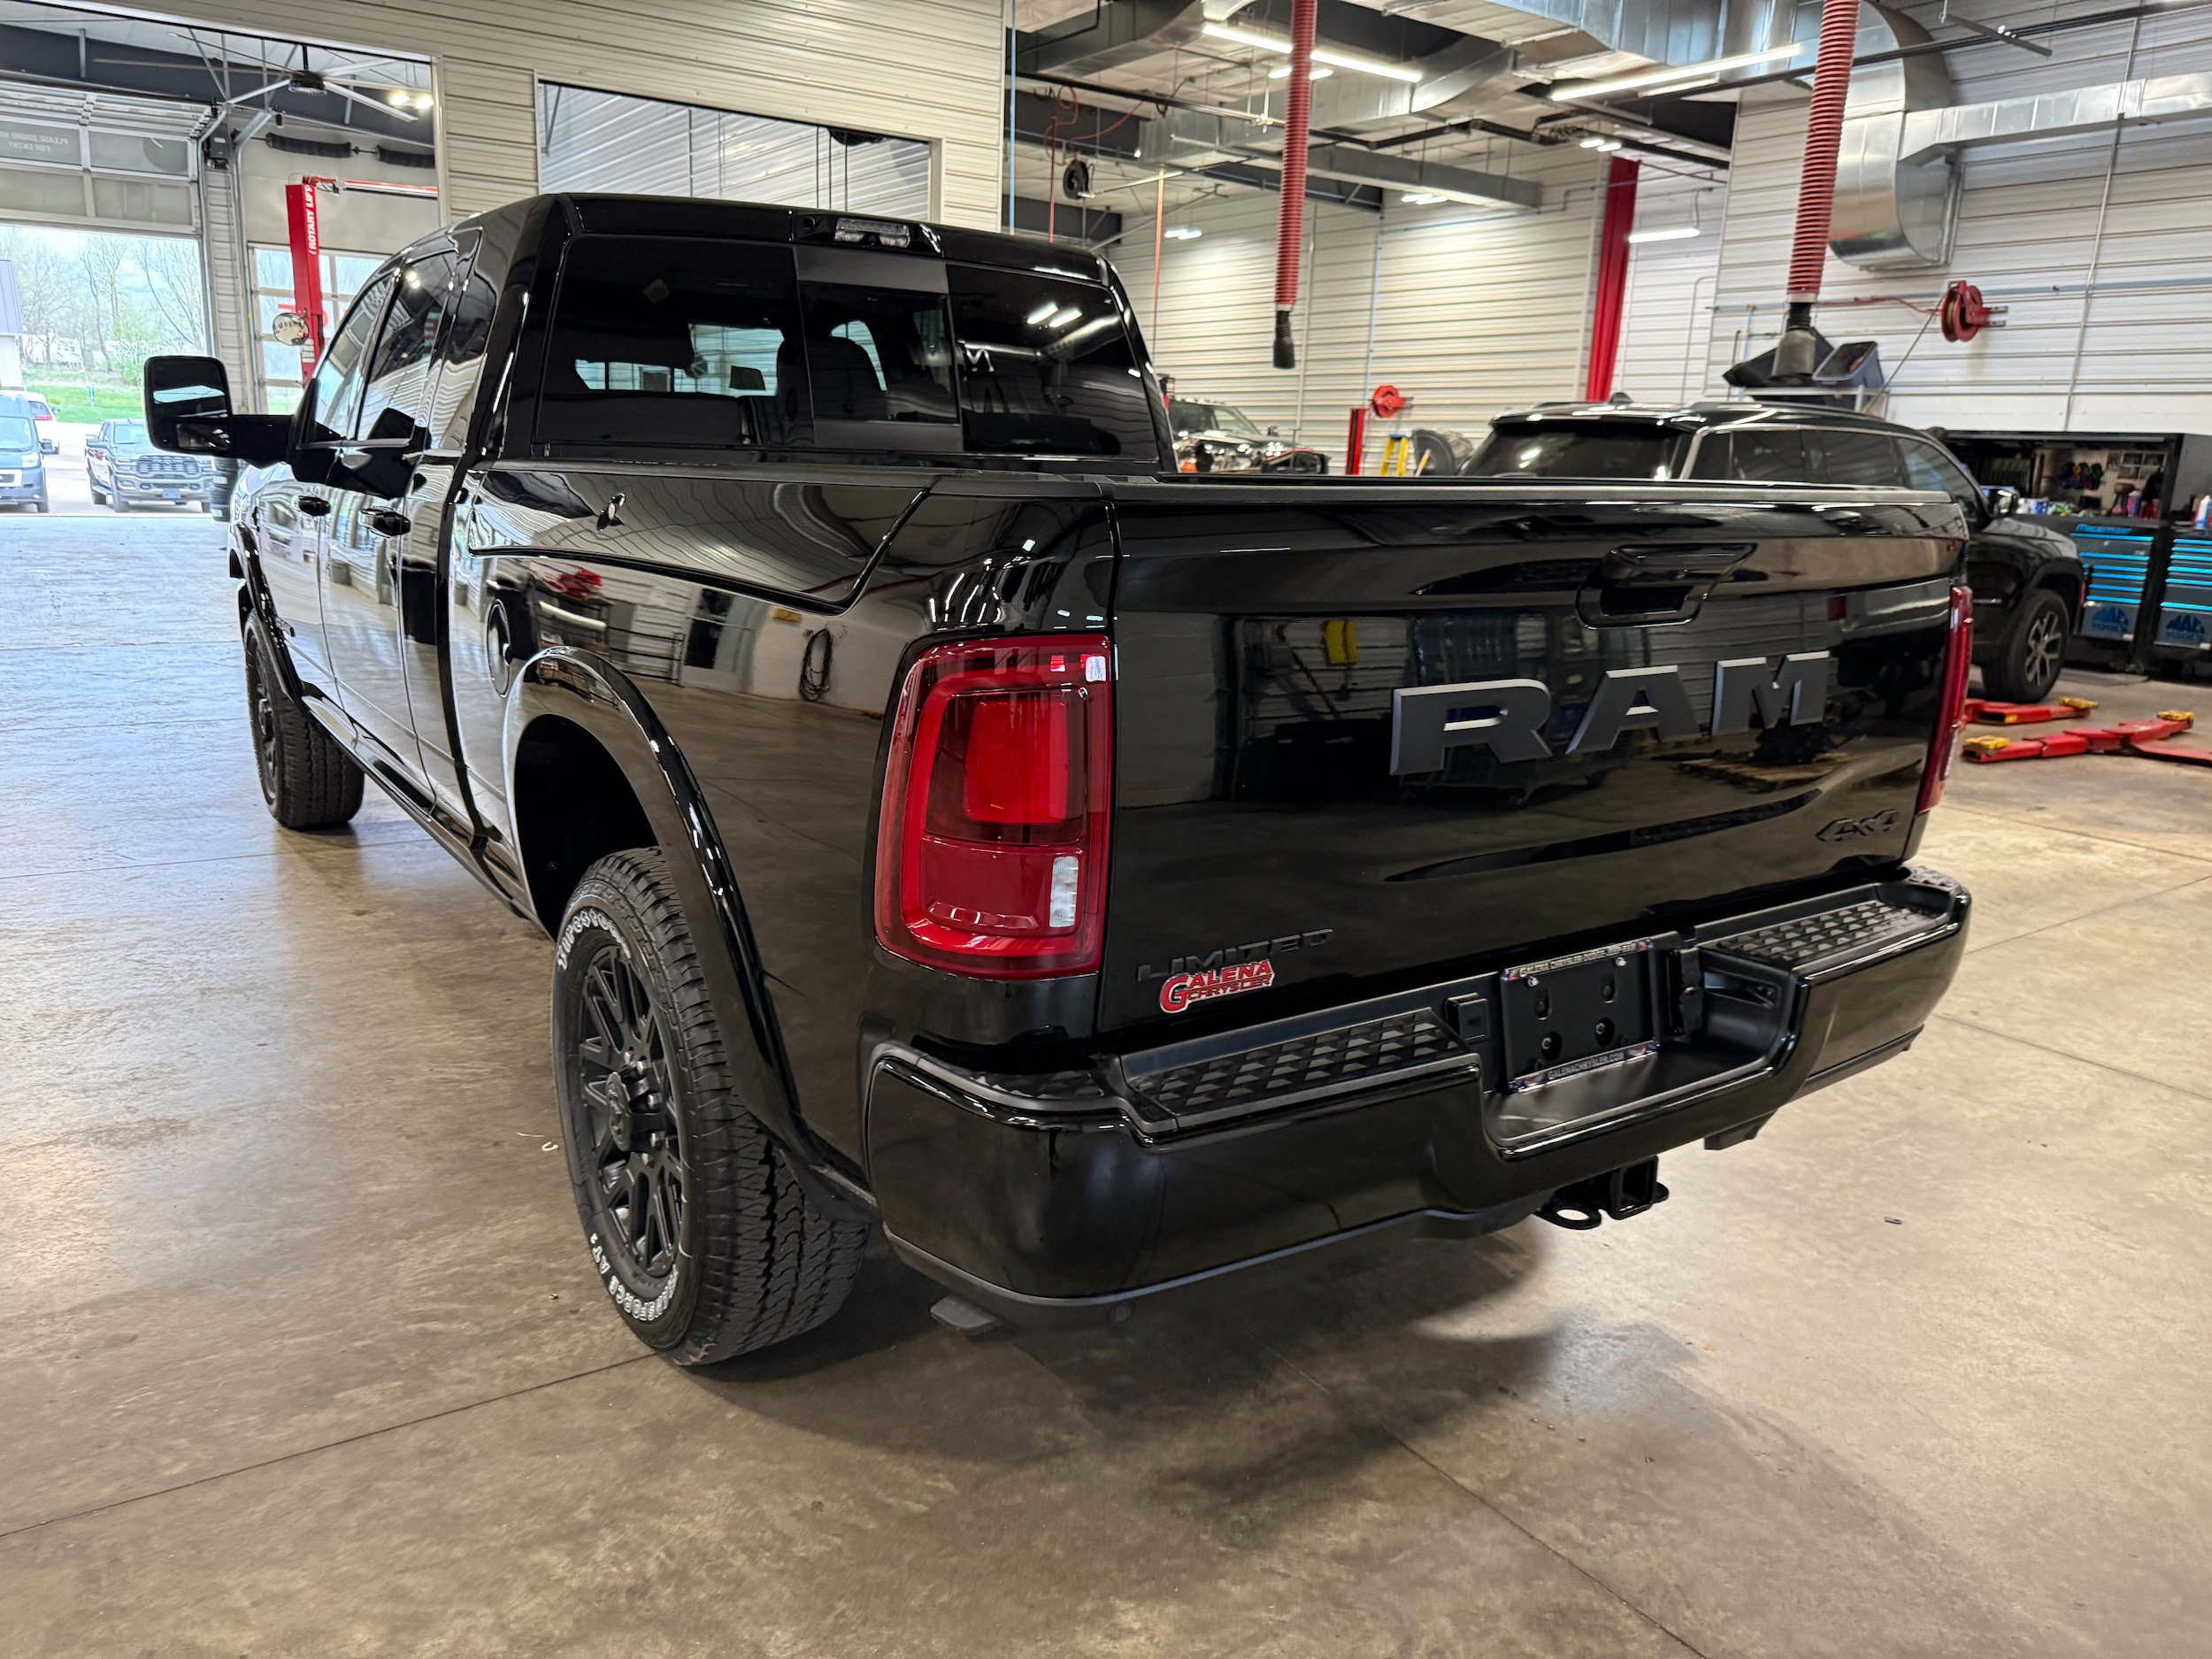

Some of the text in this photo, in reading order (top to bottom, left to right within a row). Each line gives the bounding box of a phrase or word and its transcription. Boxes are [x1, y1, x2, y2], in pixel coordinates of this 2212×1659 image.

[306, 209, 317, 250] ROTARY
[1390, 651, 1831, 775] RAM
[1137, 928, 1334, 981] LIMITED
[1160, 959, 1273, 1013] GALENA
[1187, 973, 1273, 1001] CHRYSLER
